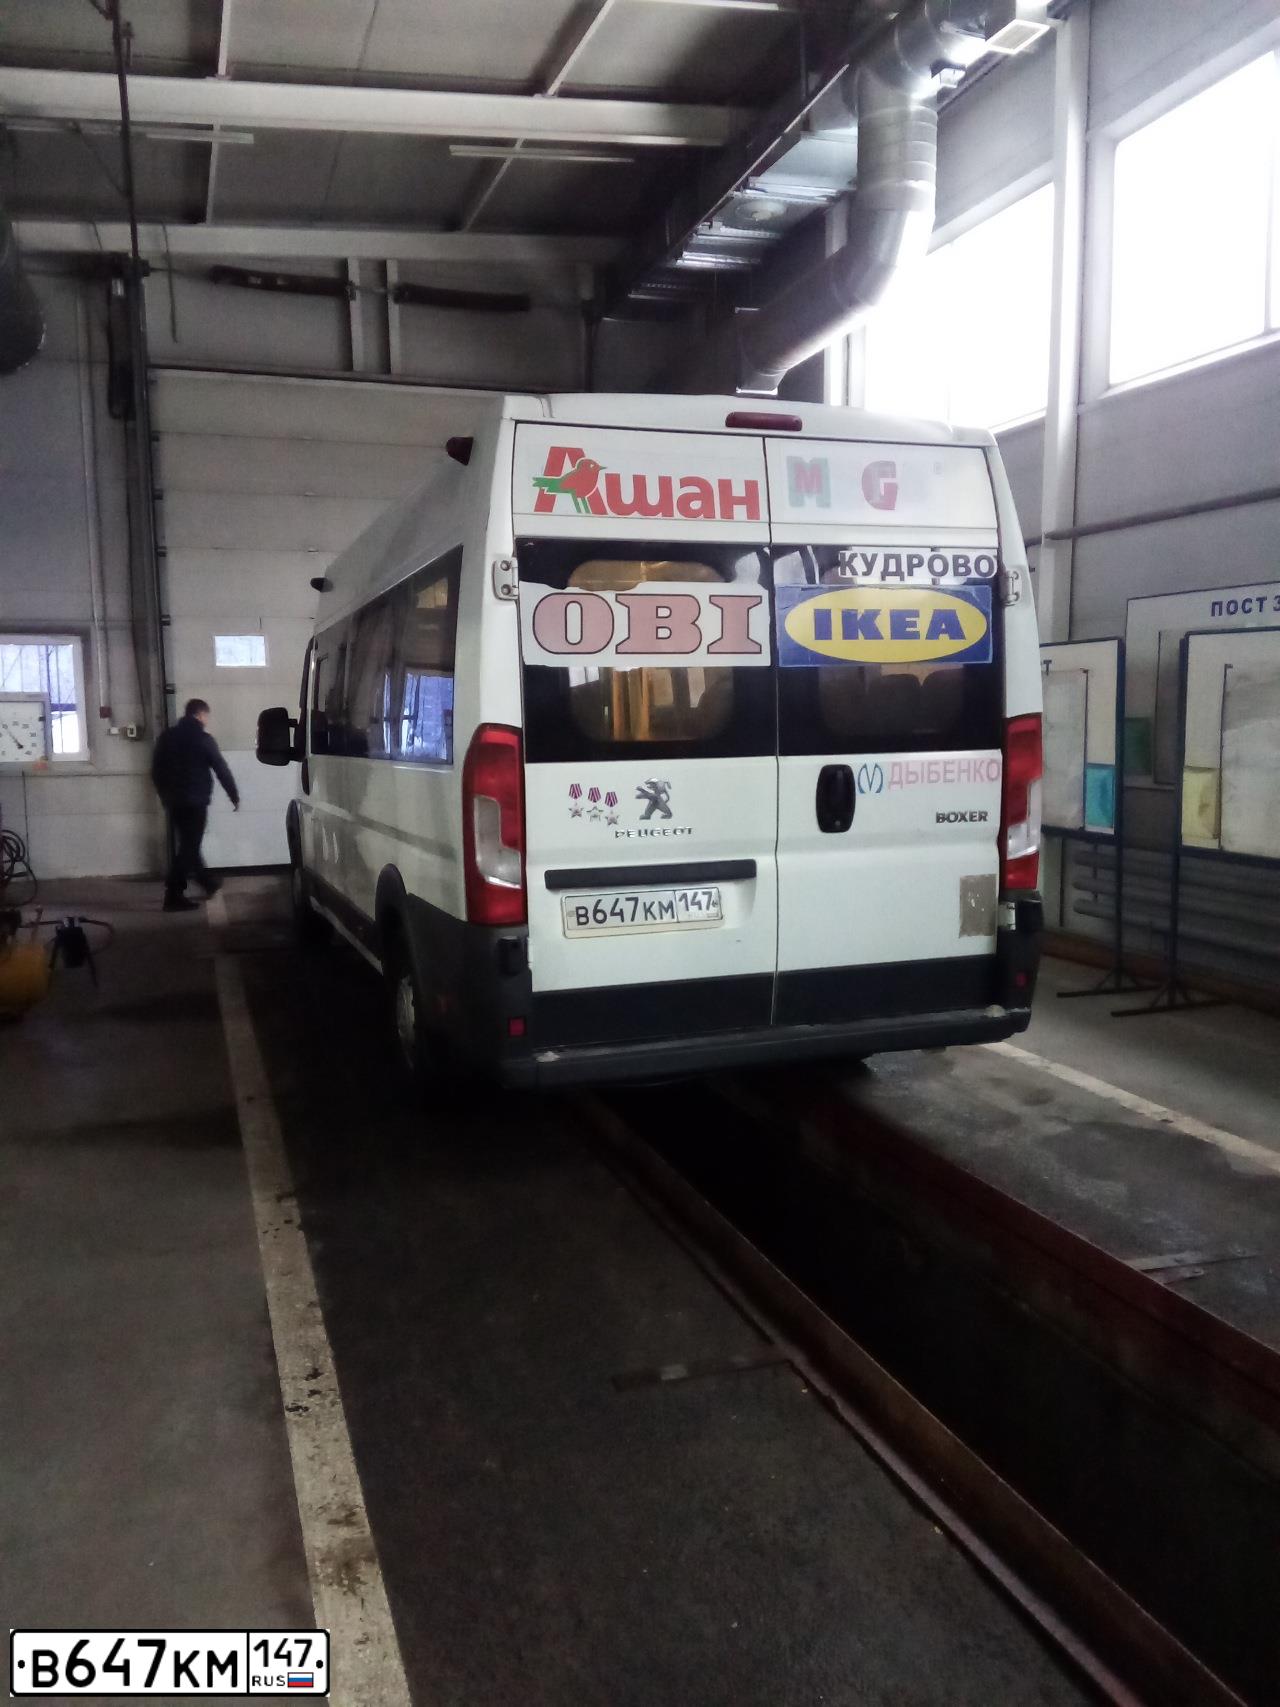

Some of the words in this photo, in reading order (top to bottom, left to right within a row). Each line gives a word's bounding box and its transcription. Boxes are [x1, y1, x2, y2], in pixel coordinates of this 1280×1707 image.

[839, 552, 995, 581] КУДРОВО
[1211, 597, 1267, 616] ПОСТ
[532, 592, 763, 655] OBI
[813, 608, 966, 640] IKEA
[888, 758, 1001, 790] ДЫБЕНКО
[935, 811, 988, 823] BOXER
[615, 826, 692, 839] PEUGEOT
[679, 891, 712, 912] 147
